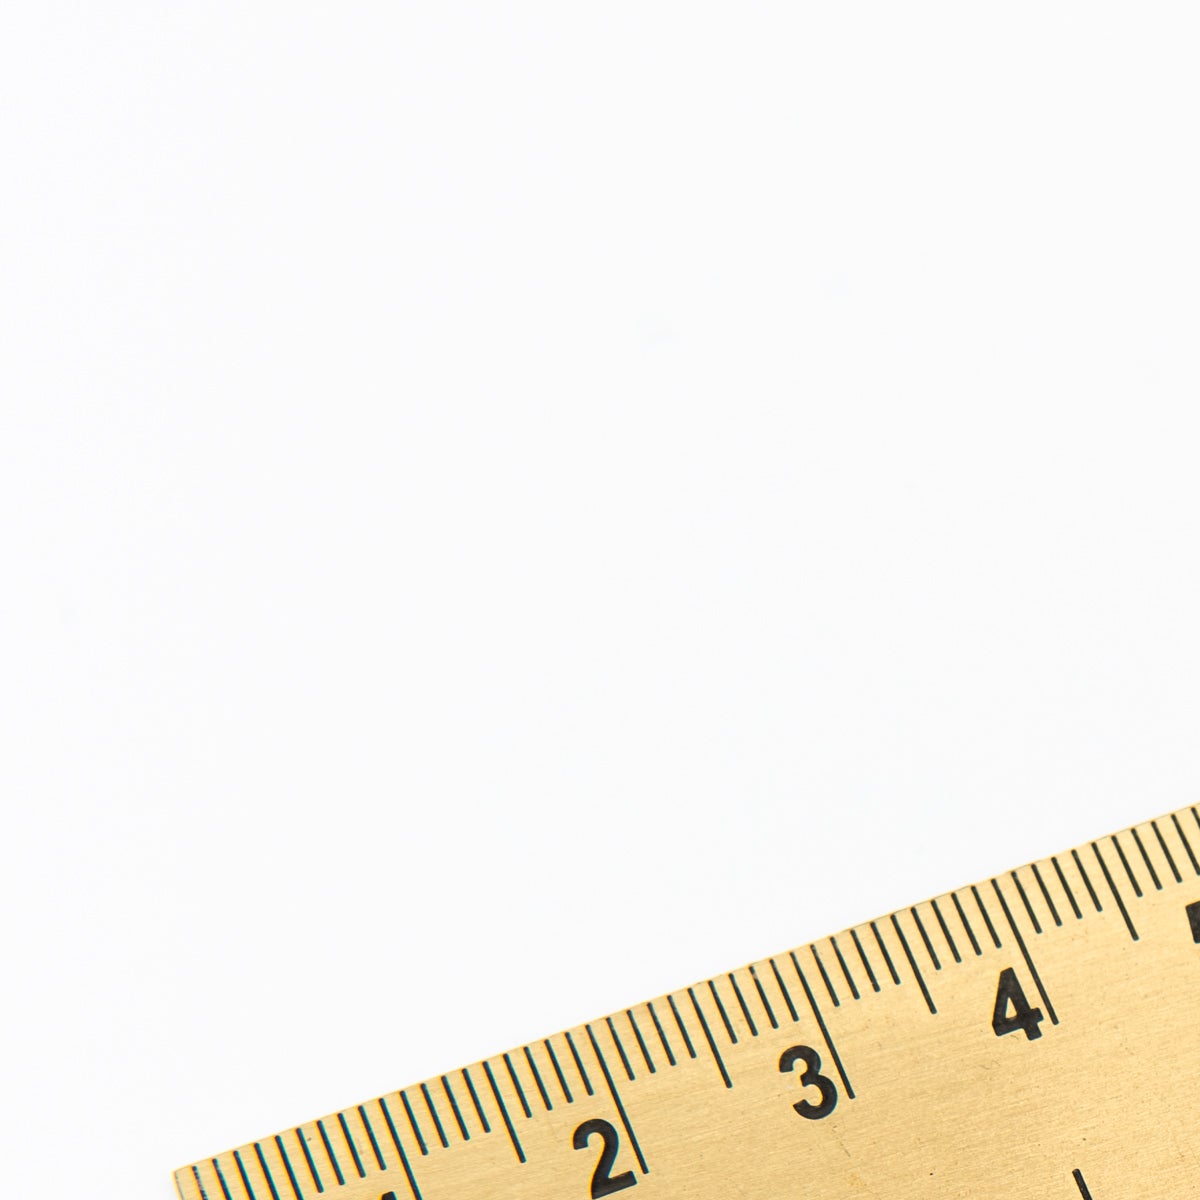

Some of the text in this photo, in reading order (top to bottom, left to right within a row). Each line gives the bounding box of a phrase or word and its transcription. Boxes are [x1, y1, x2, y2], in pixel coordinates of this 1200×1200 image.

[991, 966, 1046, 1042] 4
[778, 1044, 840, 1121] 3
[572, 1117, 638, 1200] 2
